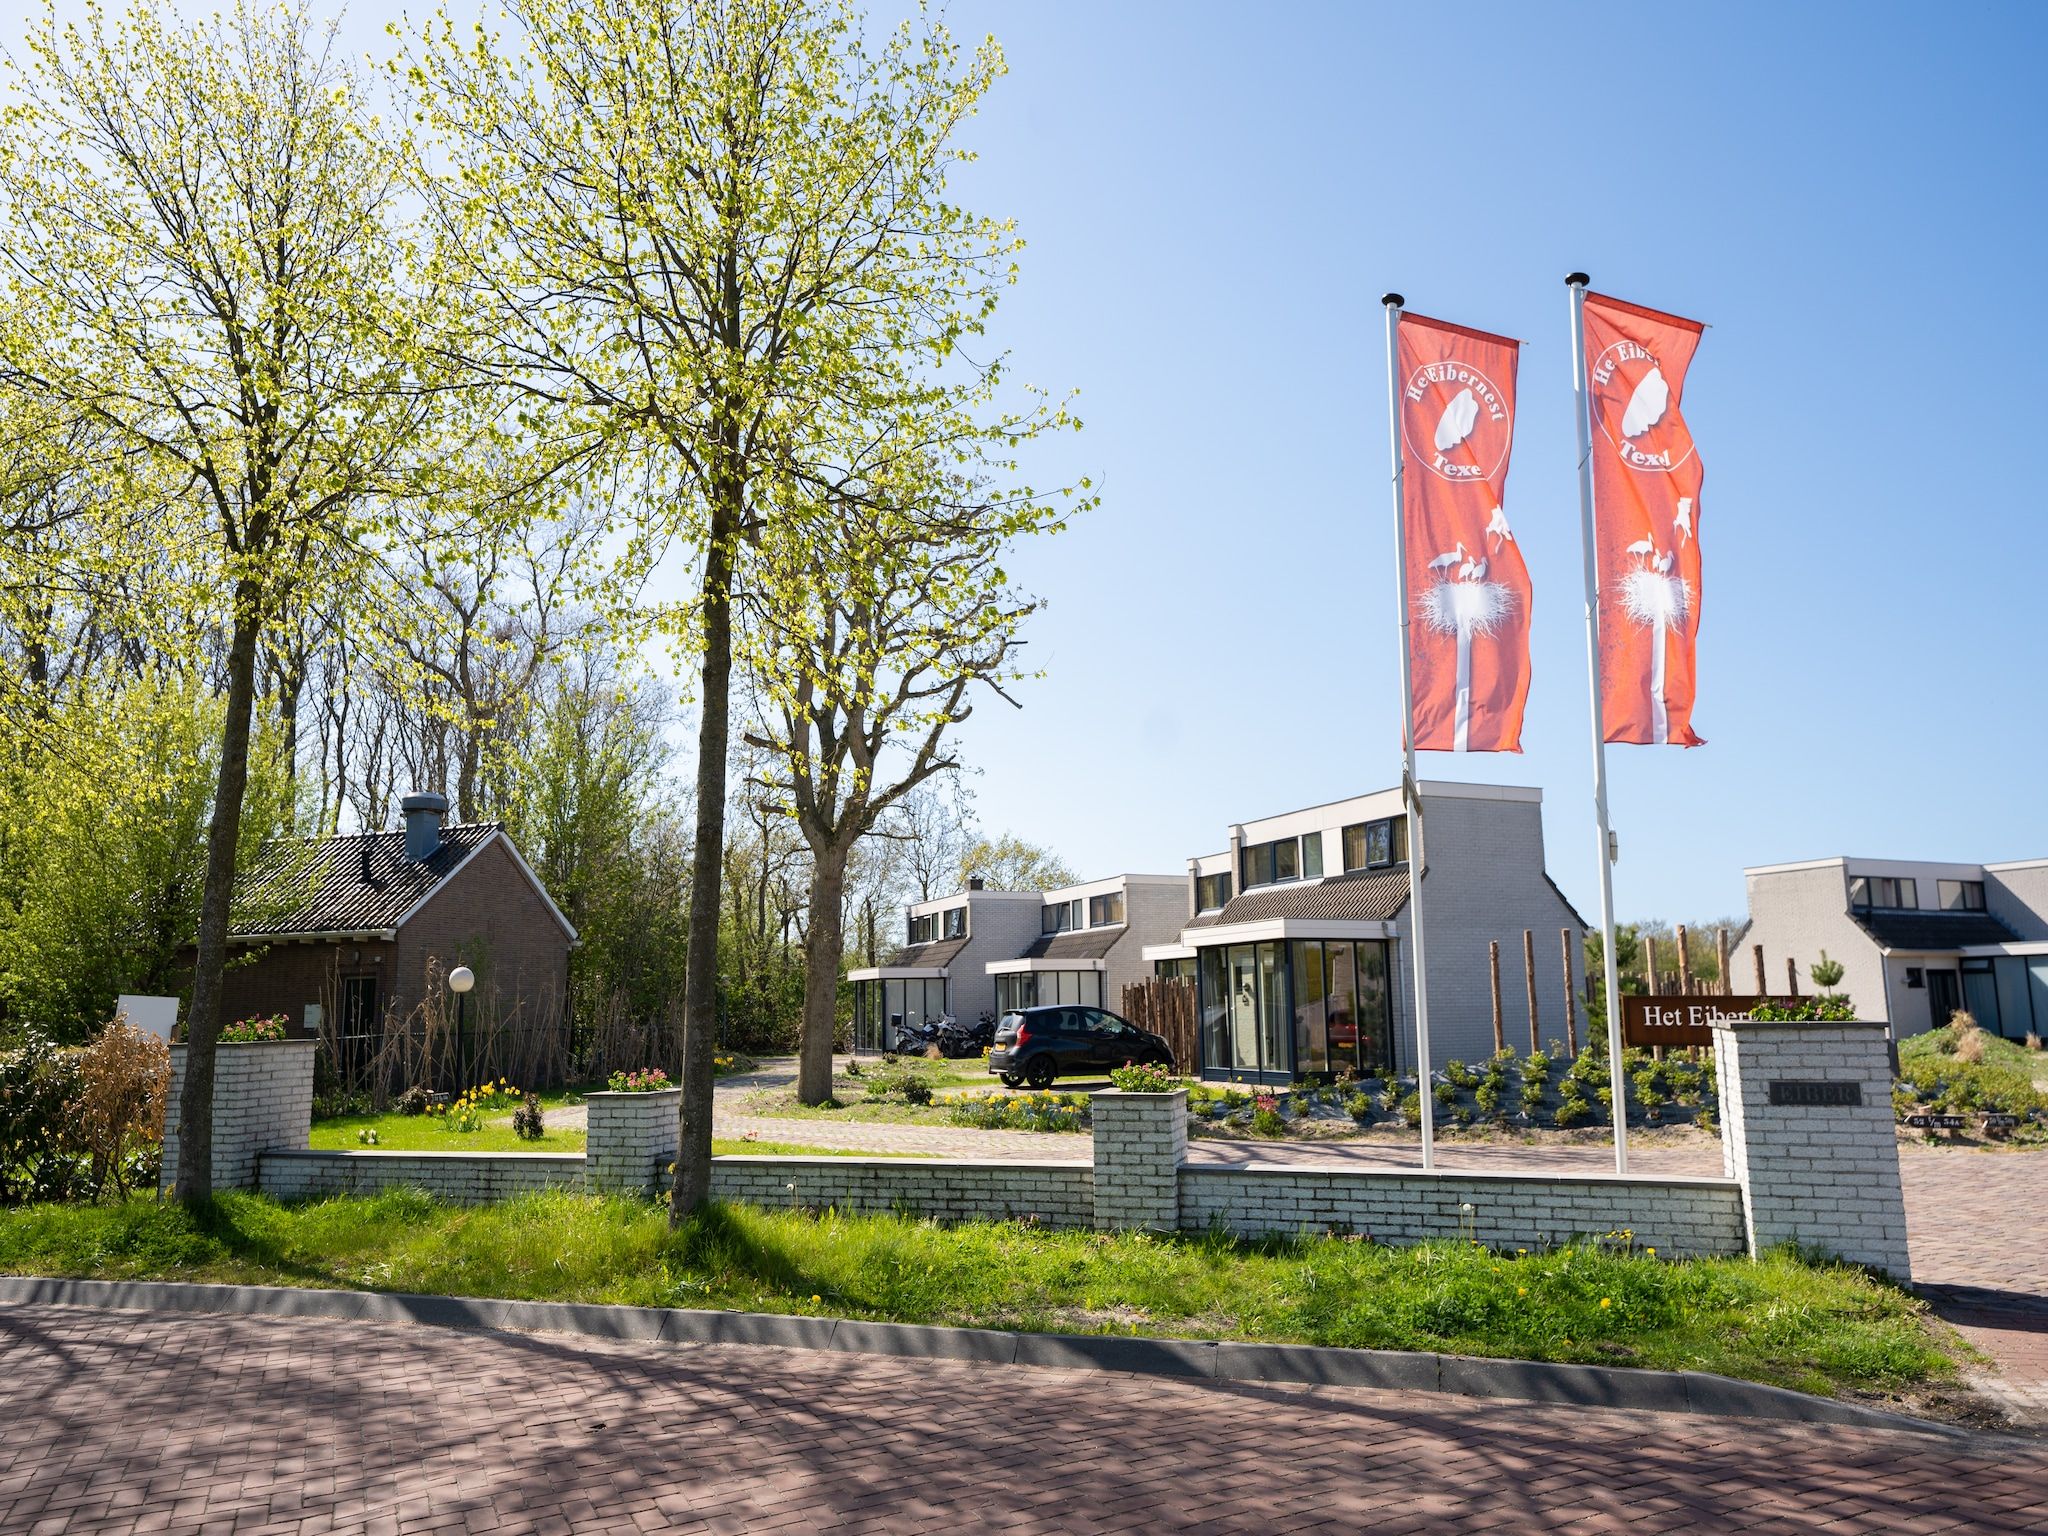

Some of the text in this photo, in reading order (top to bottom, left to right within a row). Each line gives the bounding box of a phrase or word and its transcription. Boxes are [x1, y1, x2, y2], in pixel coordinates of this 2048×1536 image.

[1595, 357, 1616, 386] He
[1425, 364, 1505, 421] Eibernest
[1432, 451, 1482, 477] Texe
[1643, 1005, 1754, 1026] Het Eiber
